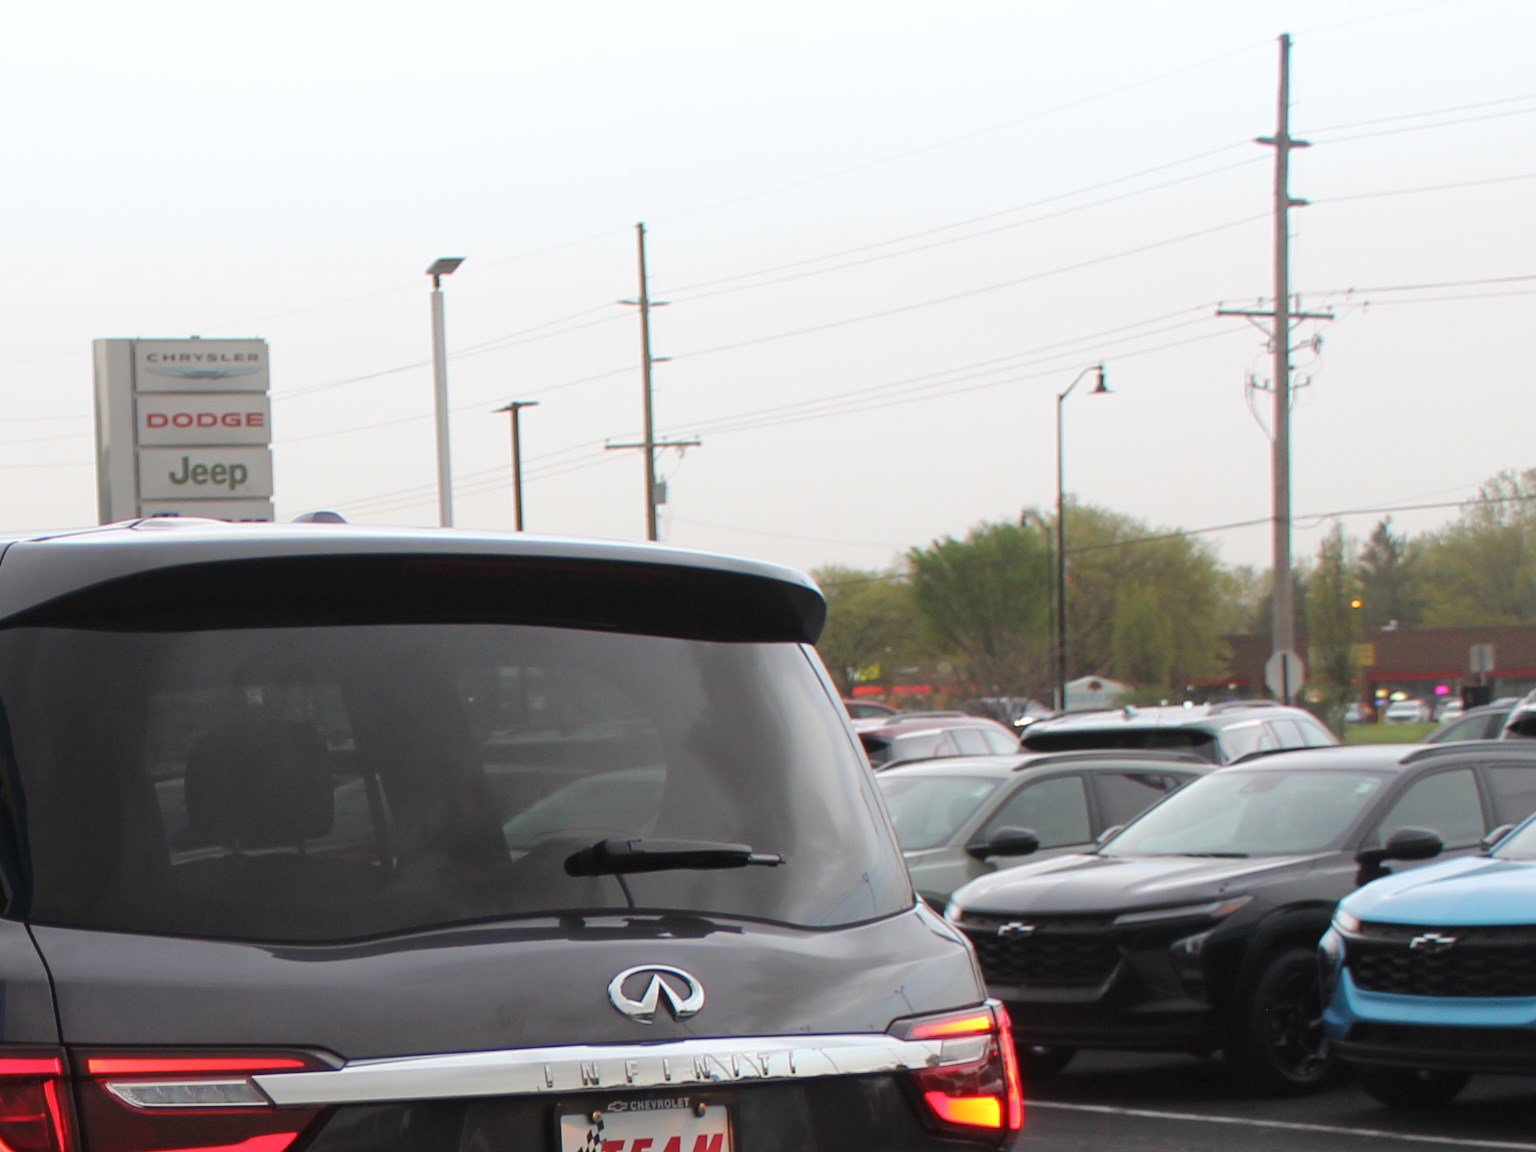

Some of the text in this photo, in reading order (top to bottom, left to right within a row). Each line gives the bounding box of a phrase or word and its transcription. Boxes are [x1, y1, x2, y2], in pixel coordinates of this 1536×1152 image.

[146, 353, 259, 363] CHRYSLER
[146, 412, 264, 428] DODGE
[168, 455, 248, 491] Jeep
[543, 1051, 797, 1088] INFINITI
[630, 1097, 690, 1112] CHEVROLET
